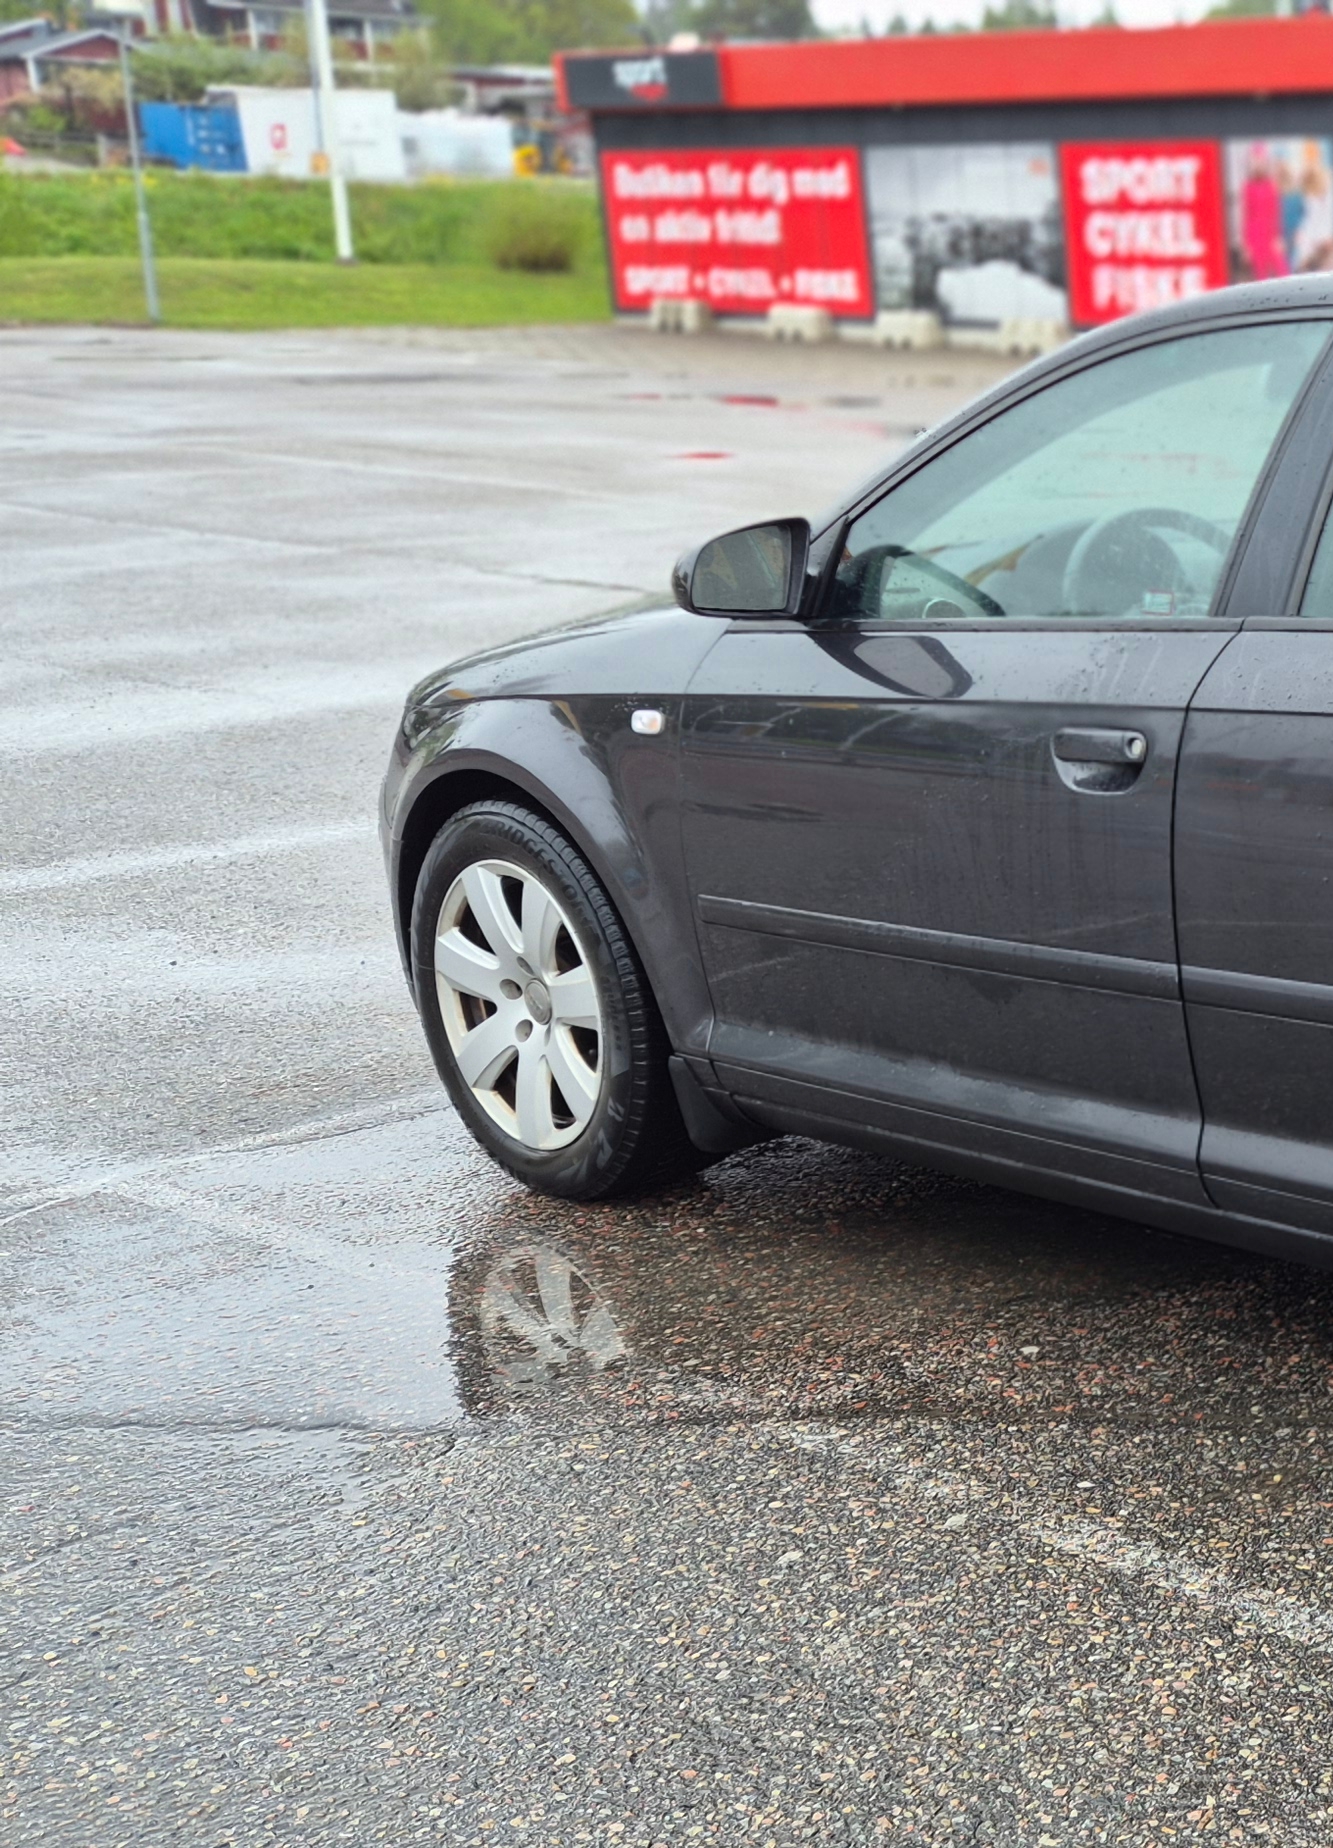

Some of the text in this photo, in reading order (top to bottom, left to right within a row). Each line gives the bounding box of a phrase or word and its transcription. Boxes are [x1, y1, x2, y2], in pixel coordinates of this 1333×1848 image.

[1081, 157, 1201, 203] SPORT
[1084, 211, 1206, 258] CYKEL
[625, 266, 689, 295] SPORT
